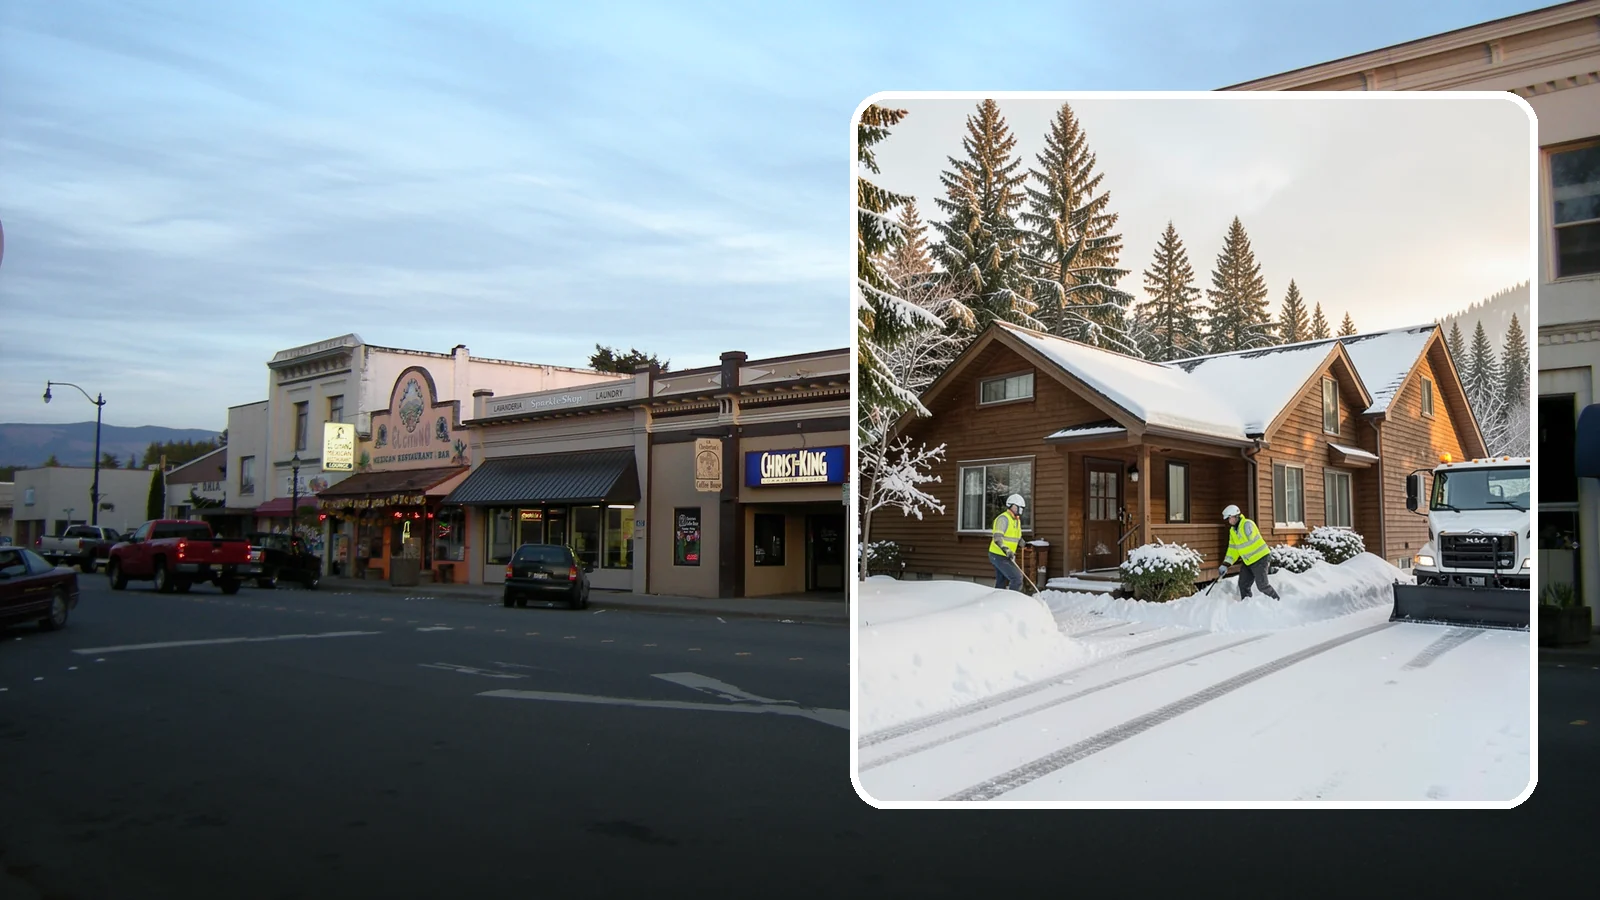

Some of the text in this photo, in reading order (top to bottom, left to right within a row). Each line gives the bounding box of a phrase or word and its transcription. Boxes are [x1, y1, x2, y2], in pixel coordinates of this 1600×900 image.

[493, 388, 623, 412] LAVANDERIA Sparkle Shop LAUNDRY
[373, 450, 450, 464] MEXICAN RESTAURANT BAR
[761, 450, 827, 477] CHRIST KING
